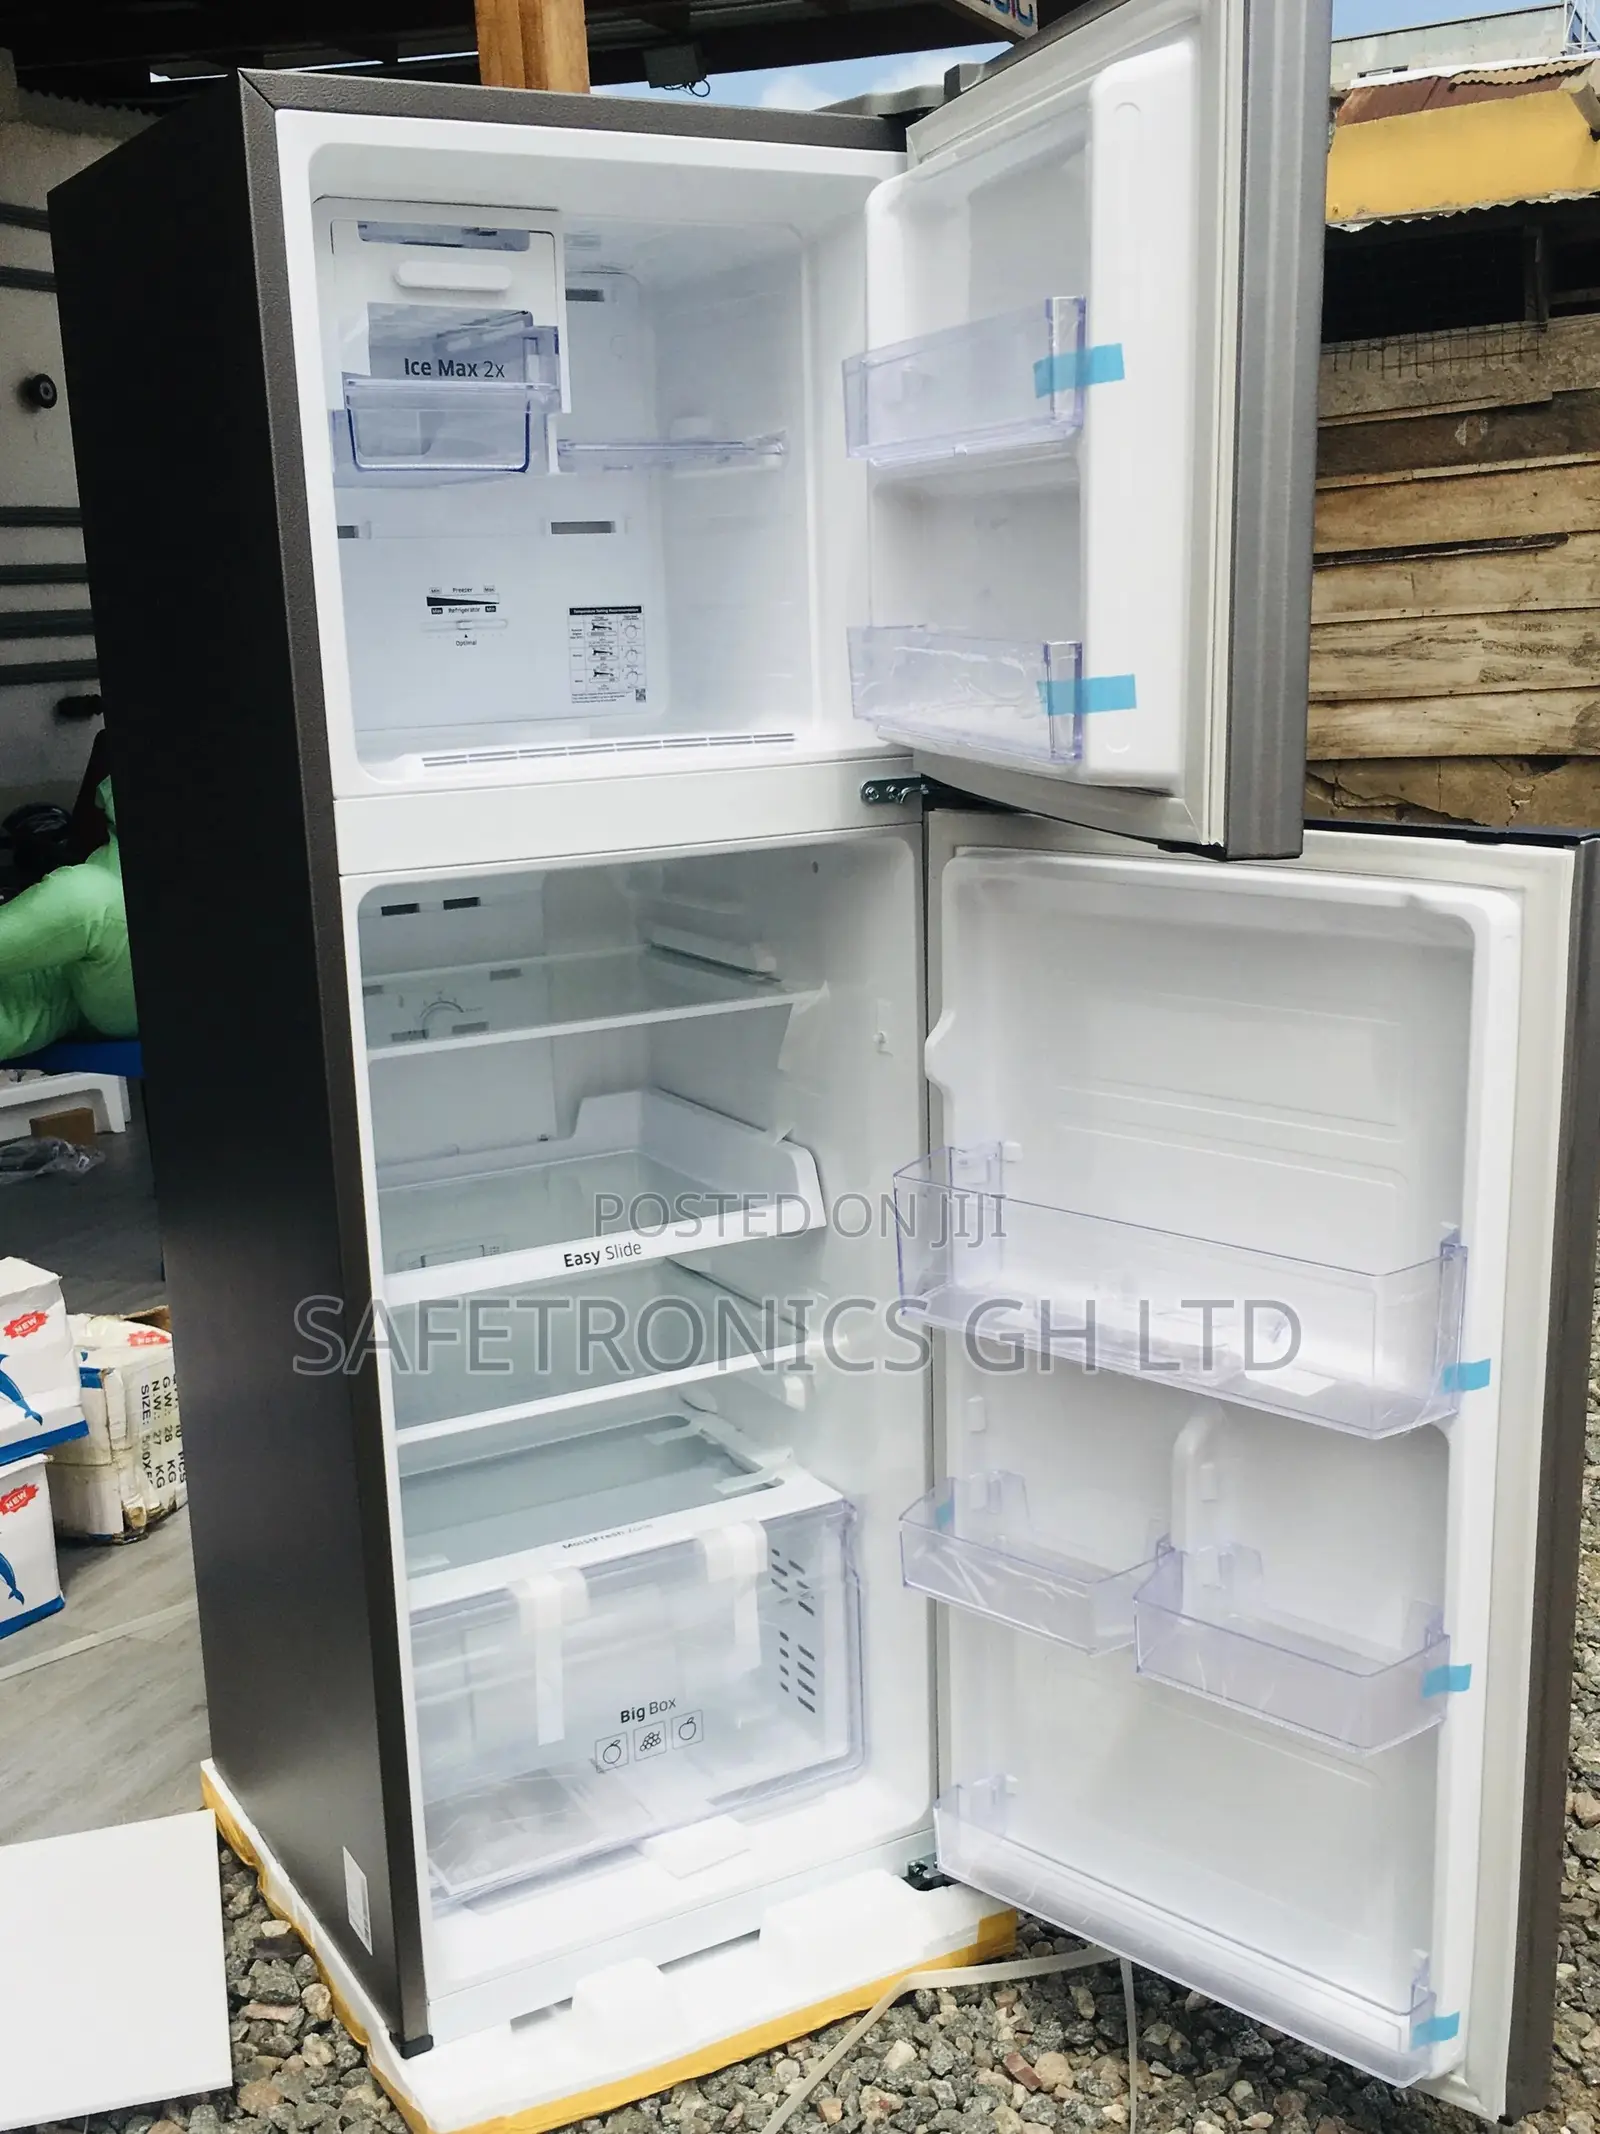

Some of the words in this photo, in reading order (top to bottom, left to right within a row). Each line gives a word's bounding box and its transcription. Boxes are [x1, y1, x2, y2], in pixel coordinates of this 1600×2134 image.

[404, 357, 432, 376] Ice
[438, 359, 478, 377] Max
[483, 360, 505, 378] 2x
[448, 606, 480, 614] Refrigerator
[564, 1250, 600, 1268] Easy
[605, 1242, 642, 1260] Slide
[14, 1316, 37, 1332] NEW
[141, 1384, 151, 1425] SIZE:
[153, 1429, 162, 1445] 27
[164, 1424, 173, 1443] 28
[155, 1464, 165, 1489] KG
[167, 1459, 177, 1483] KG
[5, 1490, 27, 1509] NEW
[620, 1707, 646, 1723] Big
[649, 1698, 677, 1715] Box
